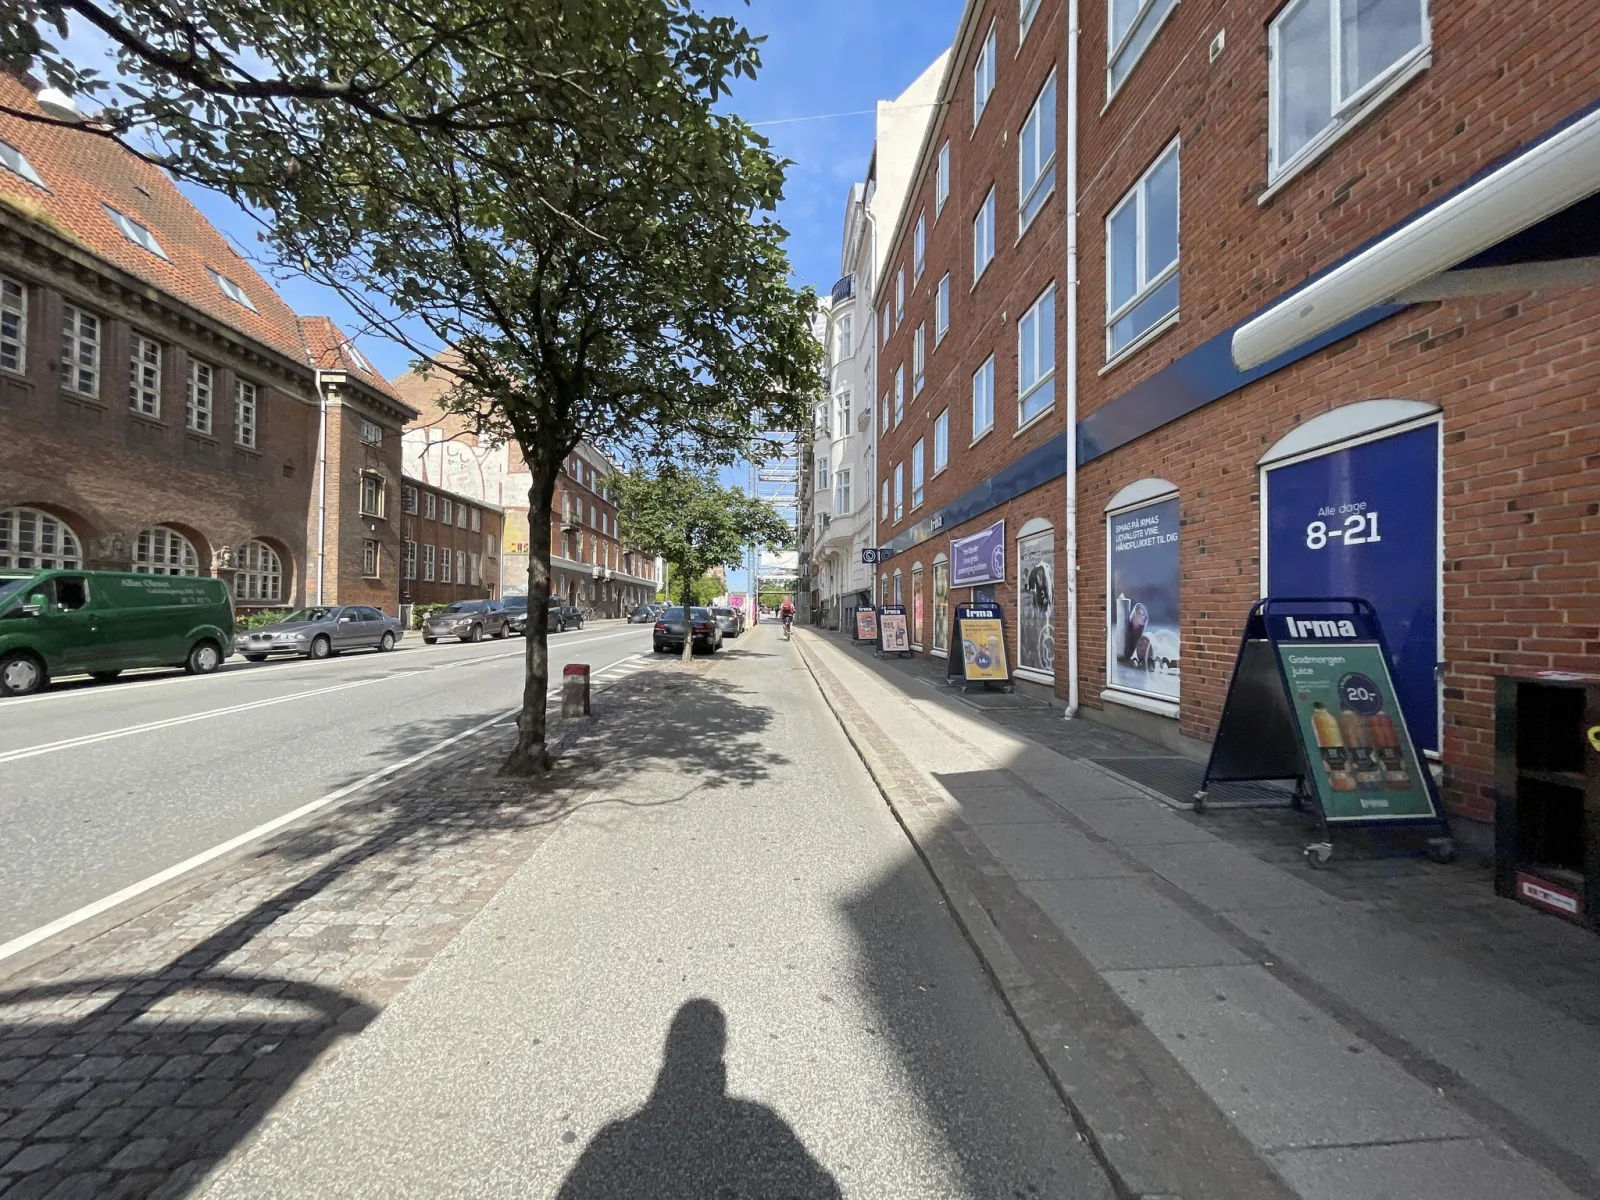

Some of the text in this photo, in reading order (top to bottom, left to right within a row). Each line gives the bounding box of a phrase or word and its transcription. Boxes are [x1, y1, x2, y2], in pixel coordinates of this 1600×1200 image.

[1318, 501, 1367, 517] Alle dage
[1115, 515, 1159, 534] SMAG PÅ IRMAS
[1306, 512, 1381, 550] 8-21
[1115, 525, 1160, 543] UDVALGTE VINE
[1115, 532, 1178, 552] HÅNDPLUKKET TIL DIG
[966, 609, 993, 618] Irma
[1286, 616, 1357, 637] Irma
[1288, 655, 1346, 666] Godmorgen
[1292, 666, 1314, 678] juice
